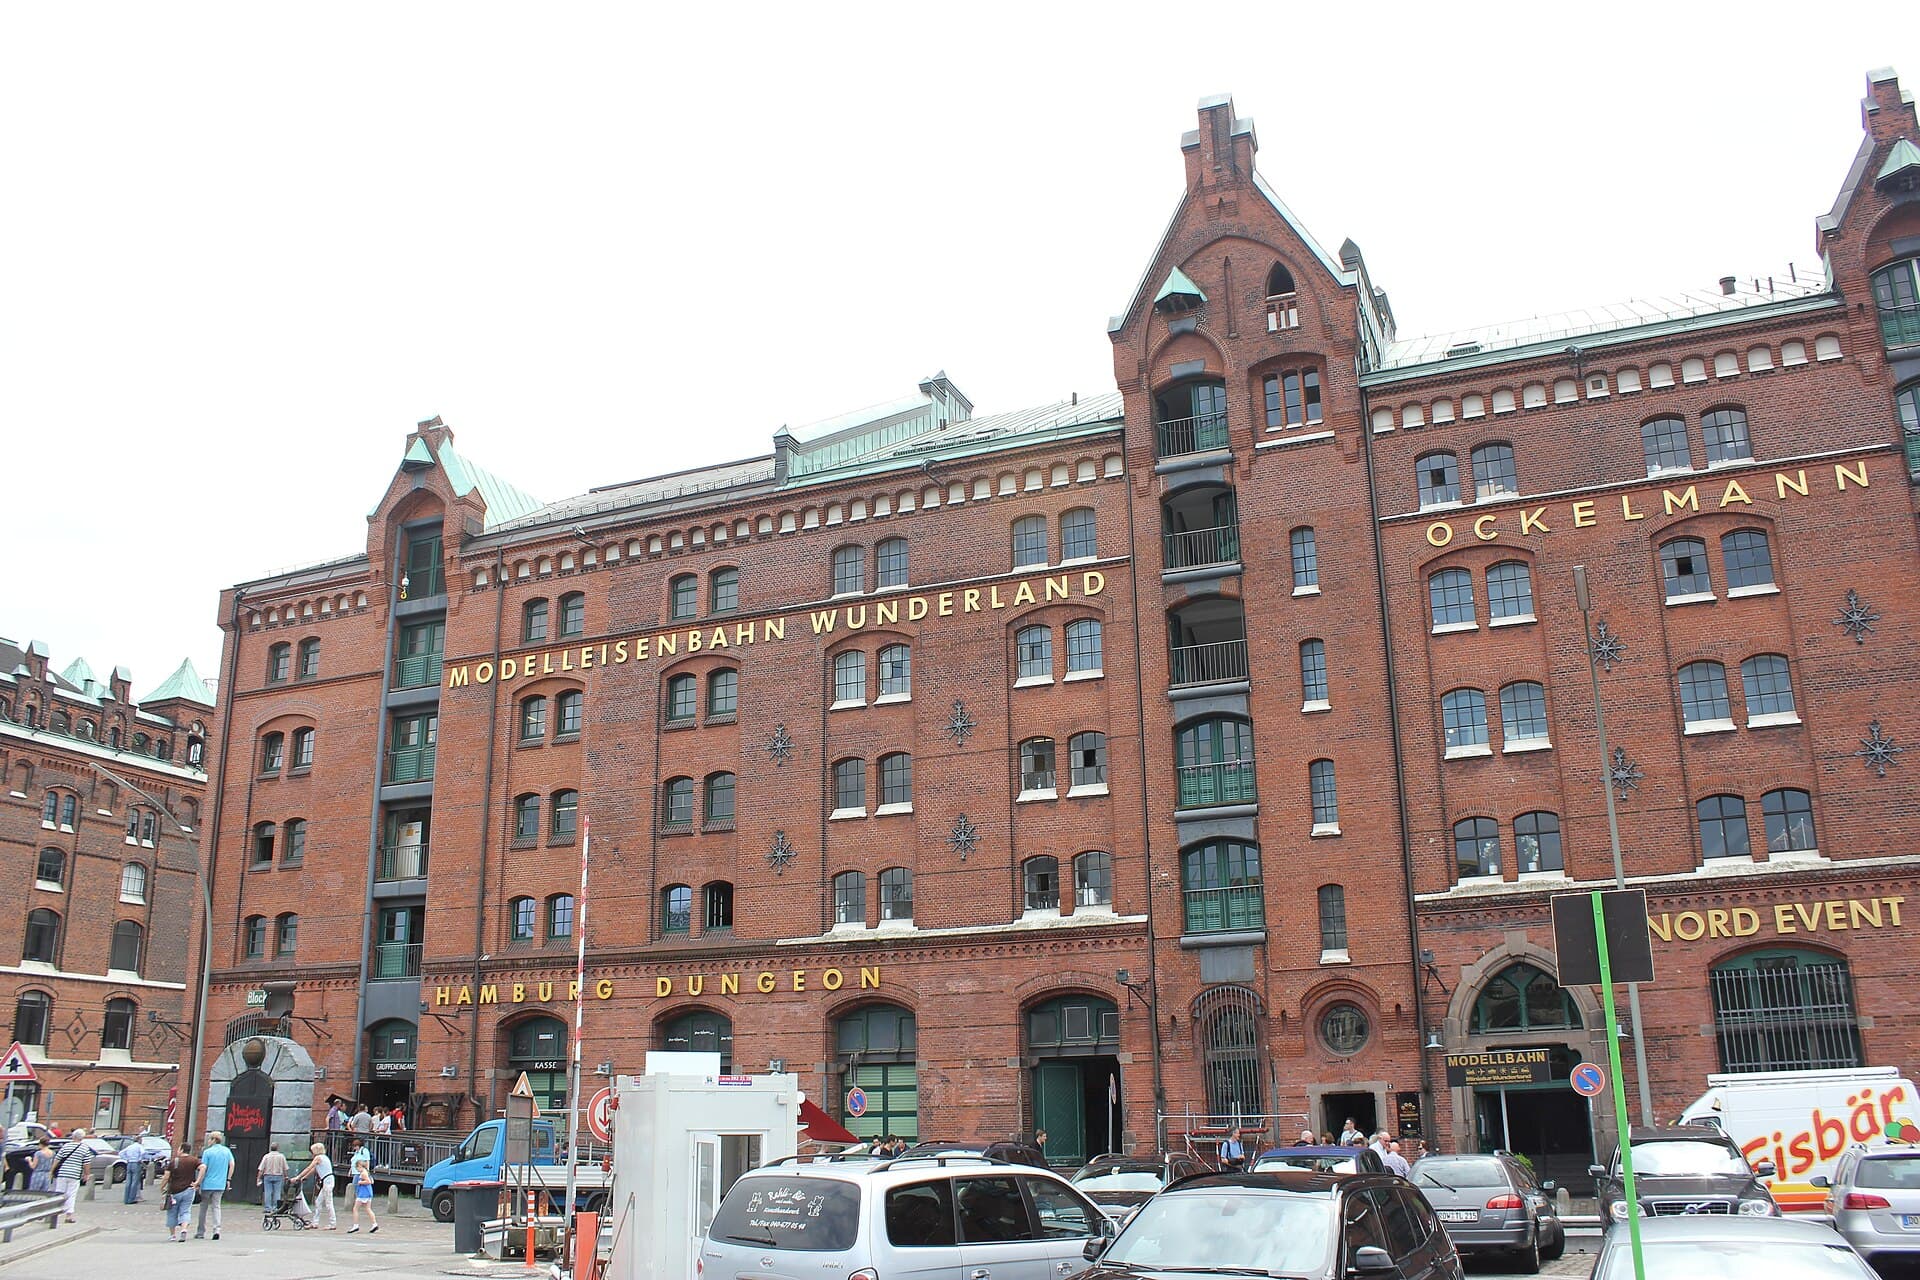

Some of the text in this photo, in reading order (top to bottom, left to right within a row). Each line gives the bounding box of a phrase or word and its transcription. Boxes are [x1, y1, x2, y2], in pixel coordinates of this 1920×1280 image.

[1426, 460, 1869, 547] OCKELMANN
[449, 571, 1106, 688] MODELLEISENBAHN WUNDERLAND
[1648, 896, 1905, 942] NORD EVENT
[436, 966, 881, 1006] HAMBURG DUNGEON
[534, 1061, 557, 1069] KASSE
[1447, 1051, 1546, 1067] MODELLBAHN
